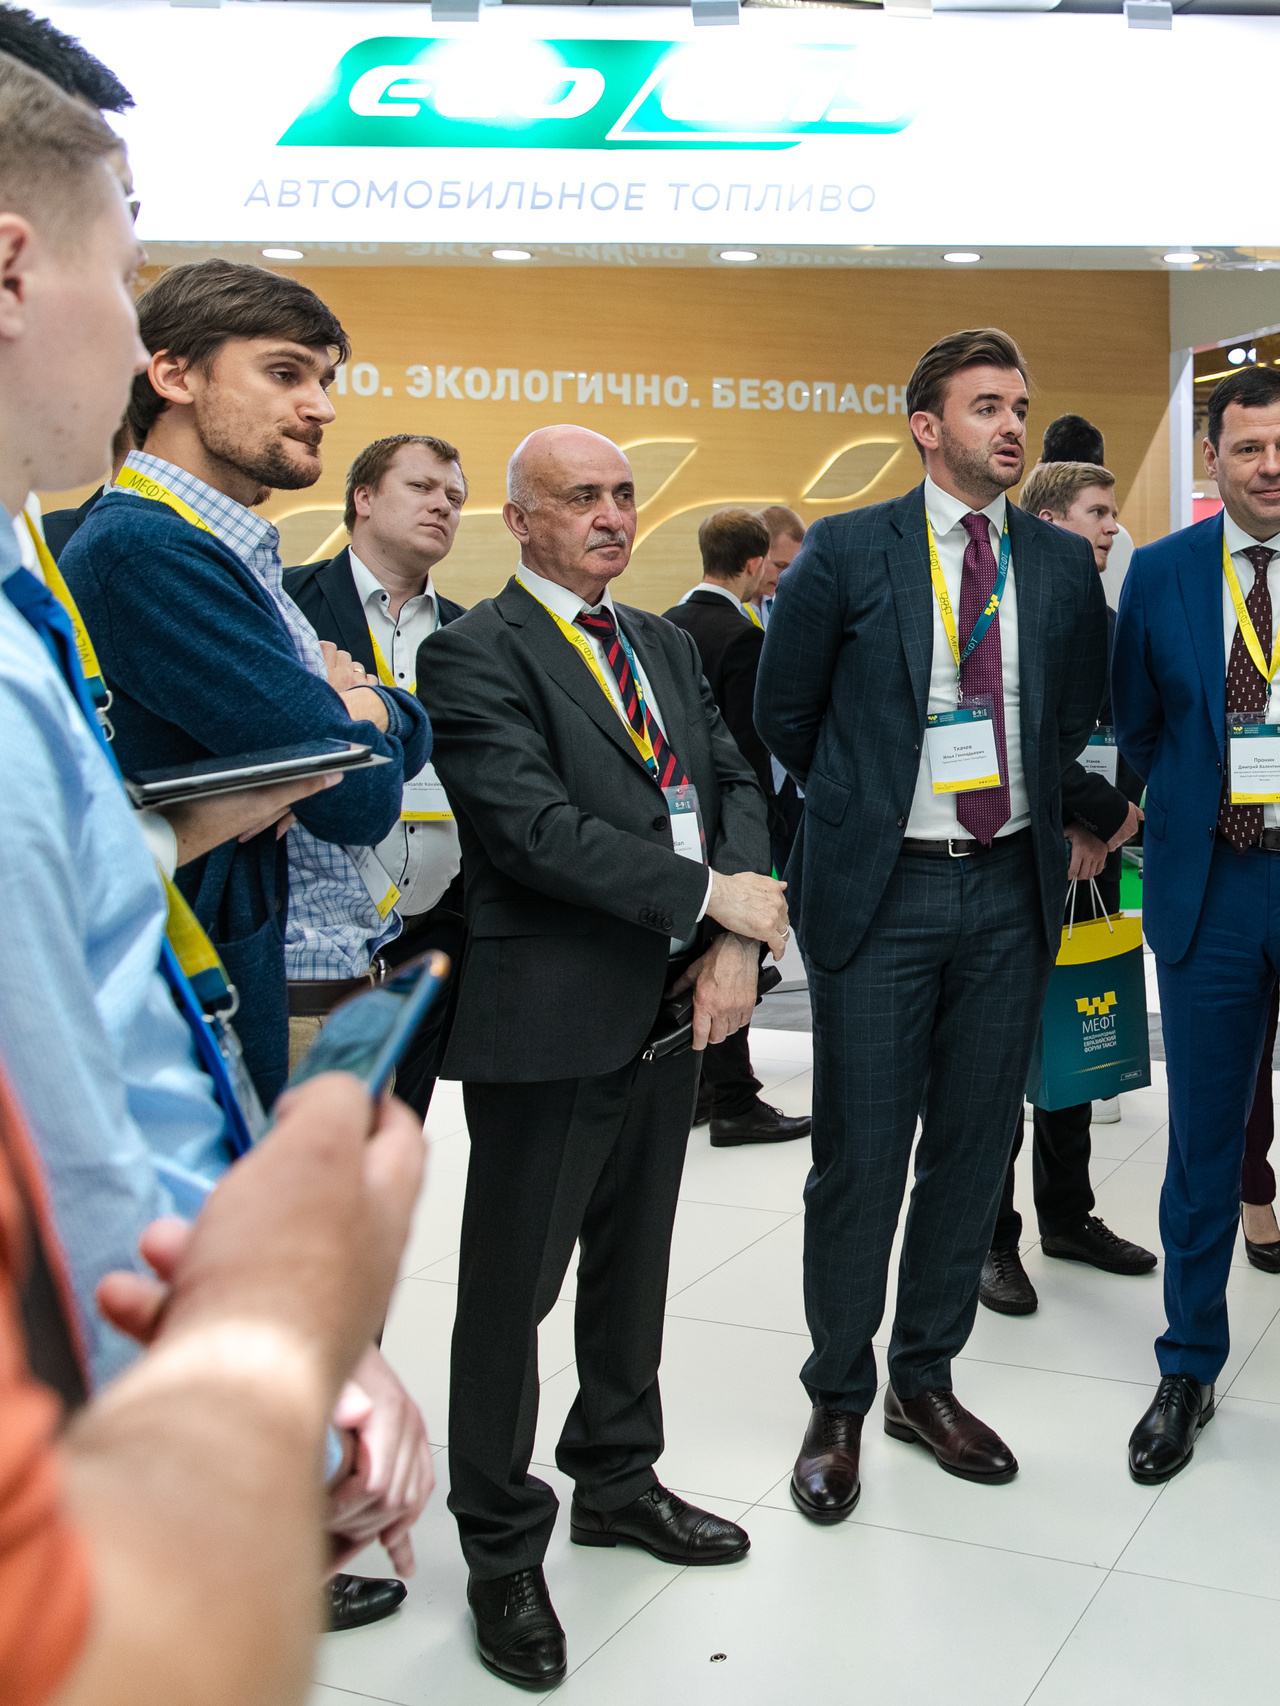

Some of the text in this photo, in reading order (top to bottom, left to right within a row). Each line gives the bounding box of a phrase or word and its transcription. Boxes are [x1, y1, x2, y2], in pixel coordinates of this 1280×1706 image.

[246, 178, 876, 213] АВТОМОБИЛЬНОЕ ТОПЛИВО
[405, 365, 699, 409] ЭКОЛОГИЧНО.
[711, 377, 908, 416] БЕЗОПАСН
[128, 474, 170, 501] МЕФТ
[929, 545, 941, 572] МЕФТ
[1235, 601, 1251, 628] МЕФТ
[572, 634, 596, 662] МЕФТ
[961, 636, 979, 663] МЕФТ
[1082, 1014, 1117, 1034] МЕФТ
[1083, 1034, 1117, 1048] ЕВРАЗИЙСКИЙ
[1084, 1040, 1117, 1053] ФОРУМ ТАКСИ
